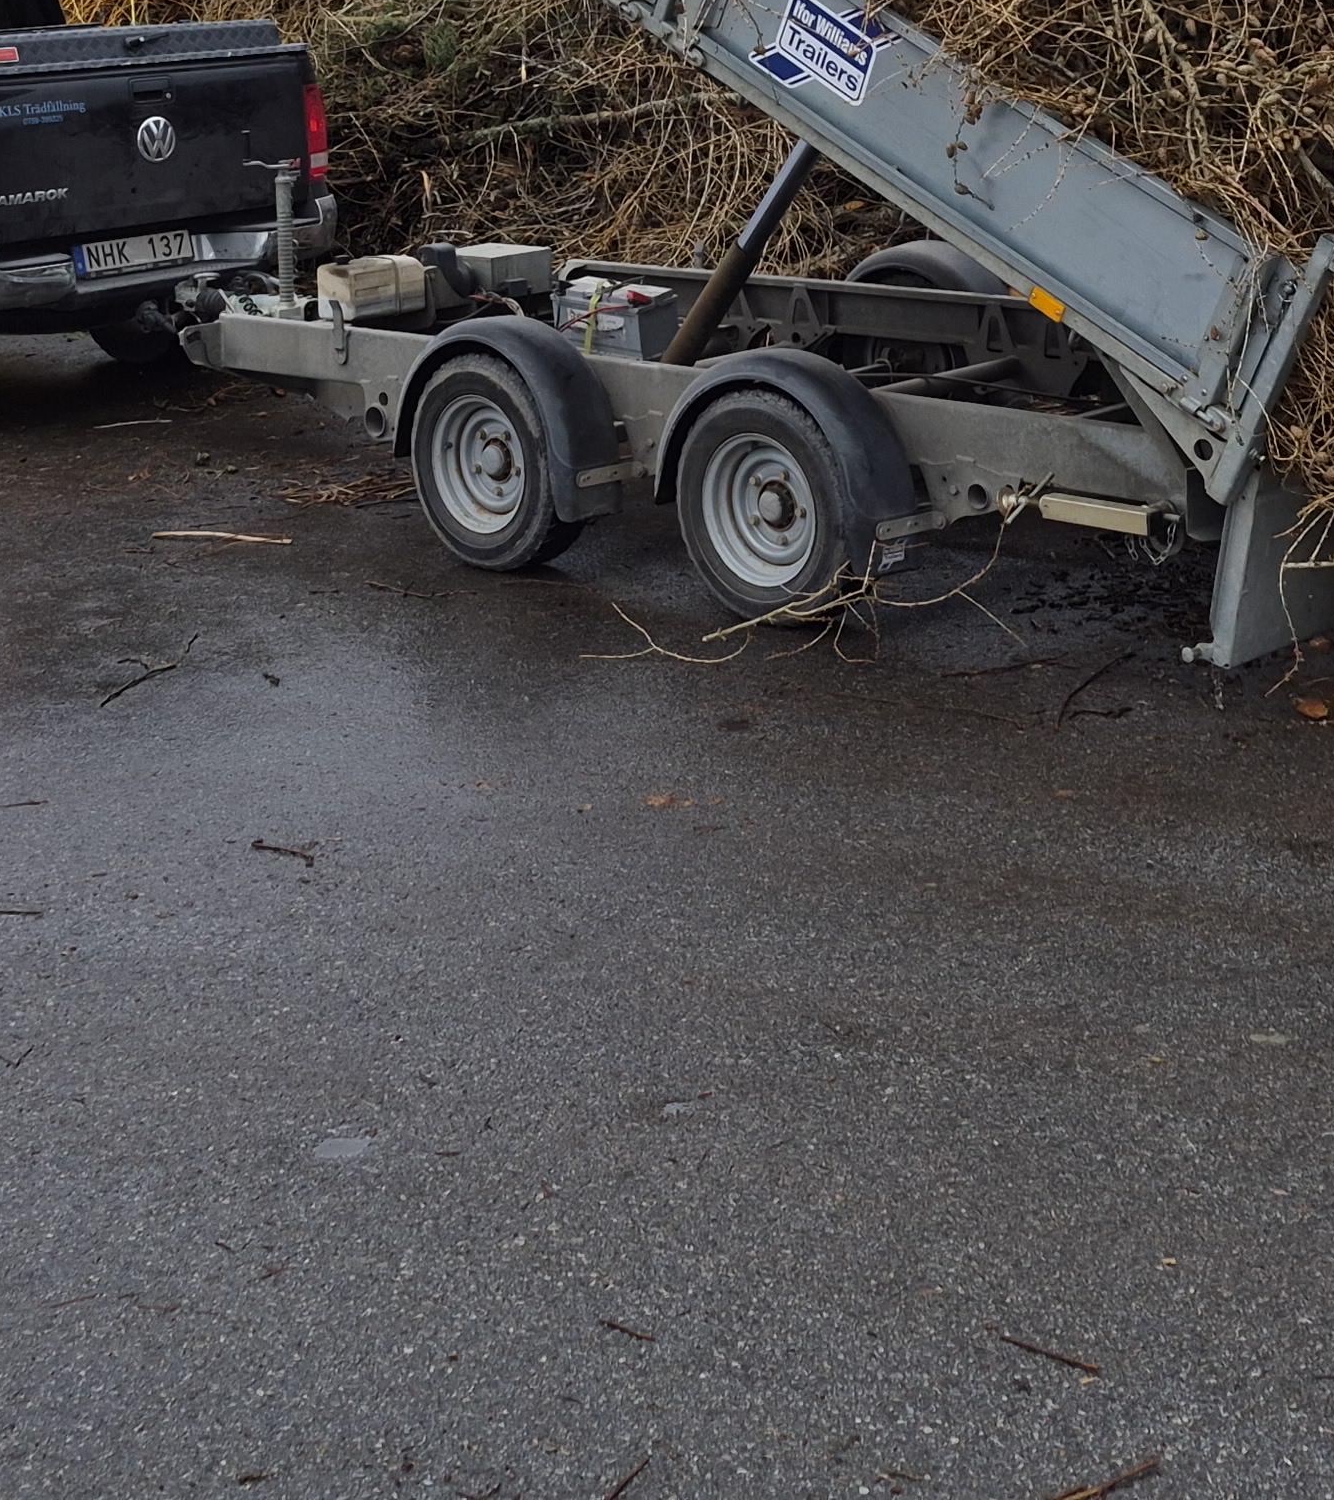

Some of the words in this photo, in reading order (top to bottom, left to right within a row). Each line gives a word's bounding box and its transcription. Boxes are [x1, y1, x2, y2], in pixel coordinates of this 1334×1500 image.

[792, 0, 816, 28] Ifor
[788, 25, 859, 92] Trailers
[86, 240, 131, 269] NHK
[147, 232, 185, 259] 137
